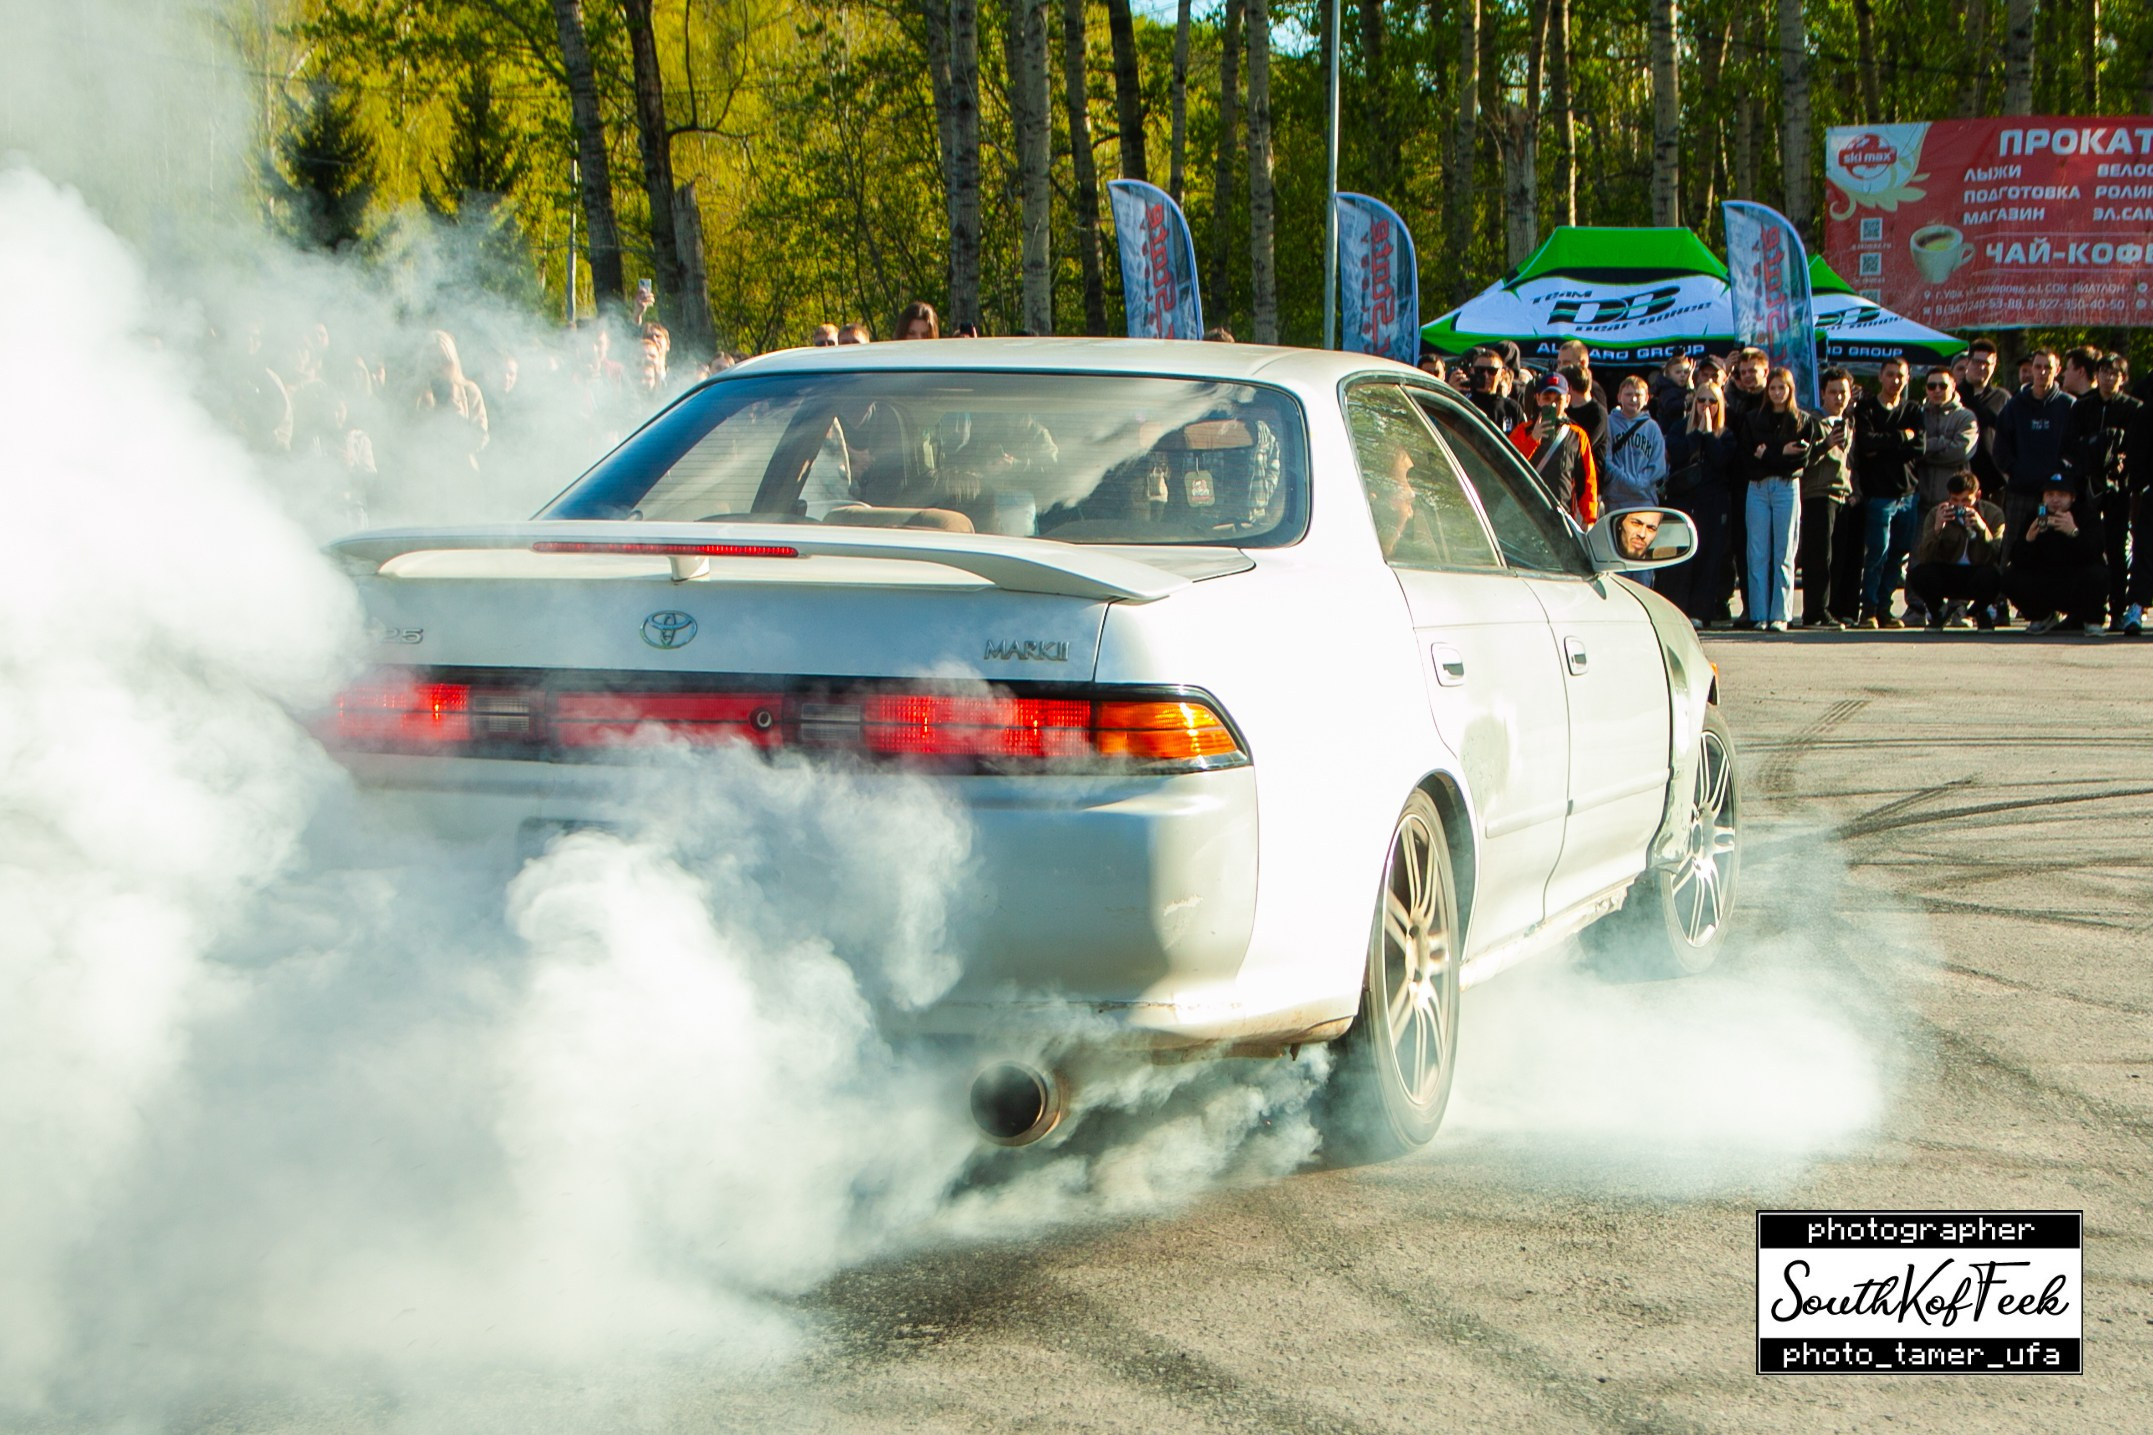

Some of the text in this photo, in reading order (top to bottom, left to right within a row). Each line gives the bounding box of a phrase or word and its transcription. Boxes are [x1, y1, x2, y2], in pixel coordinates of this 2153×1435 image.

[2000, 128, 2153, 156] ПРОКАТ
[1963, 164, 2022, 182] ЛЫЖИ
[1963, 186, 2081, 204] ПОДГОТОВКА
[1963, 207, 2045, 225] МАГАЗИН
[1537, 342, 1628, 361] ALARD
[1849, 346, 1903, 358] GROUP
